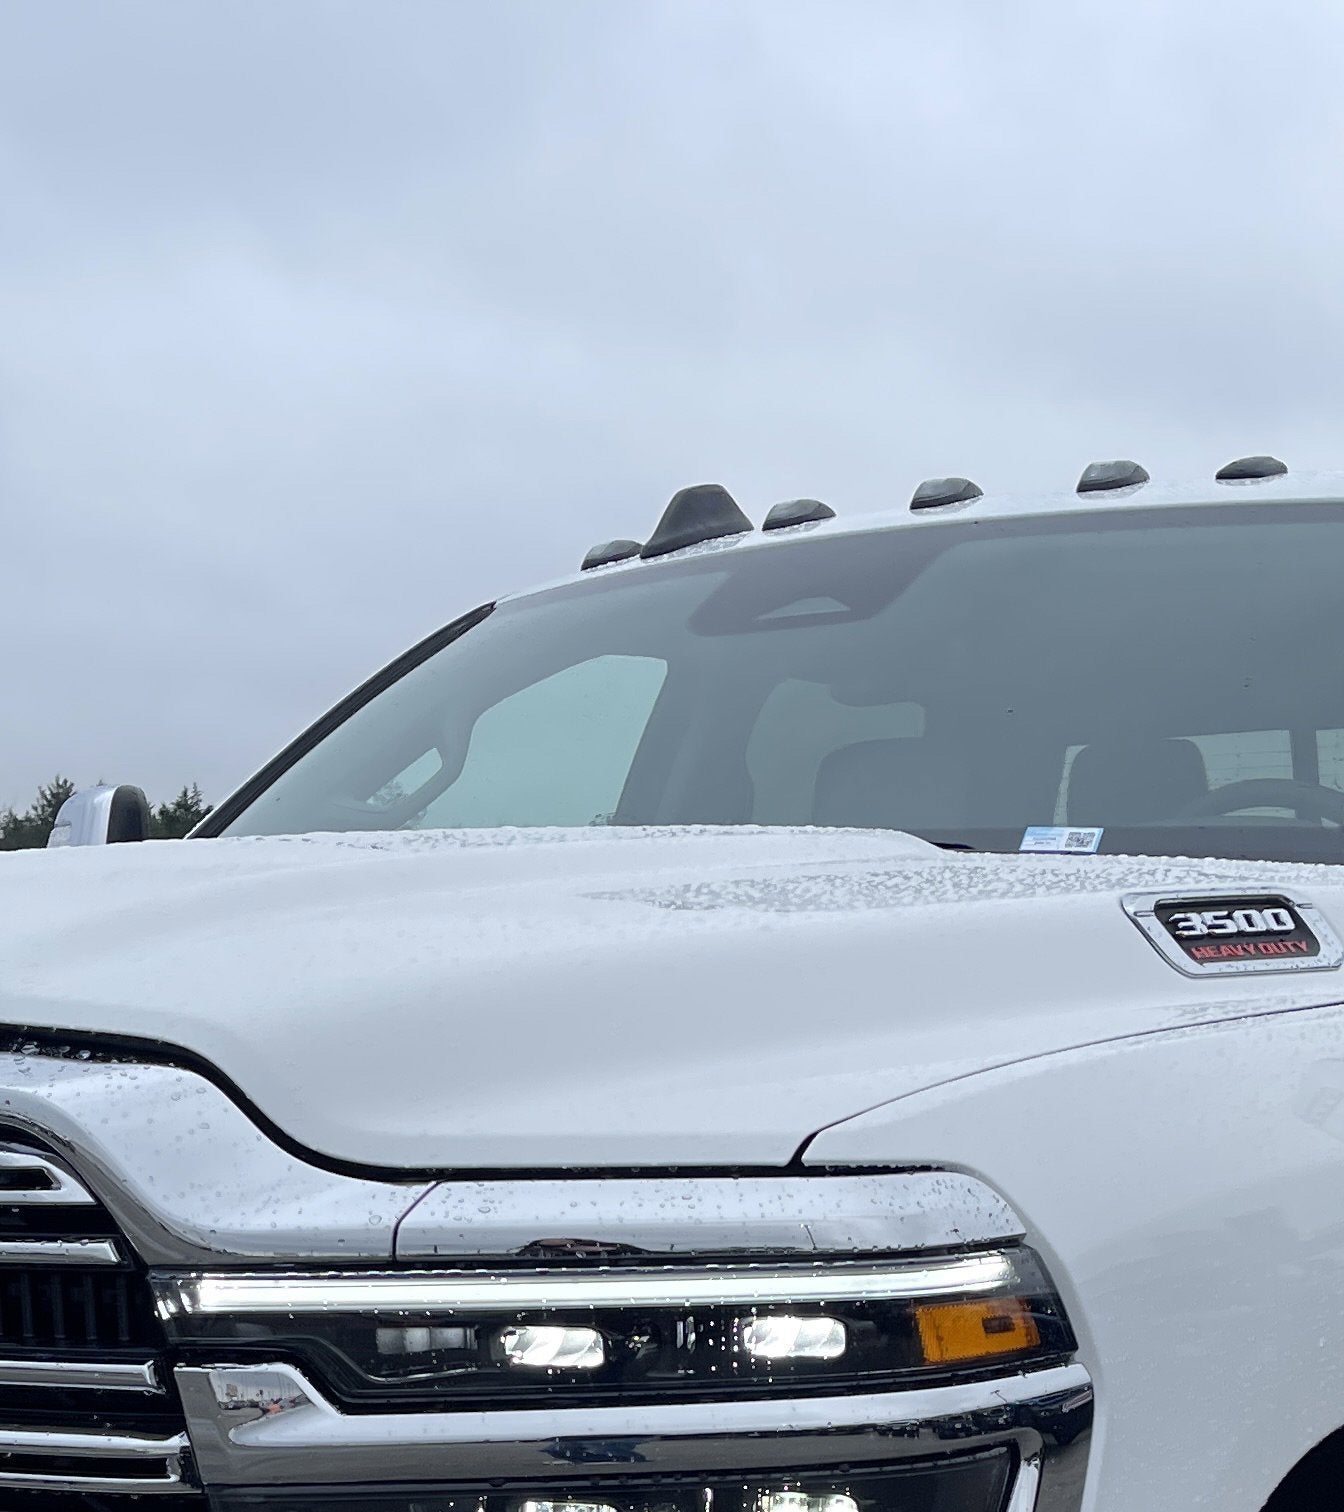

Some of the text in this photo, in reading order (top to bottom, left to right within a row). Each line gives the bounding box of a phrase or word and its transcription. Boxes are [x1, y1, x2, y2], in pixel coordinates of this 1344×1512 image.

[1168, 908, 1296, 936] 3500
[1190, 940, 1309, 960] HEAVY DUTY
